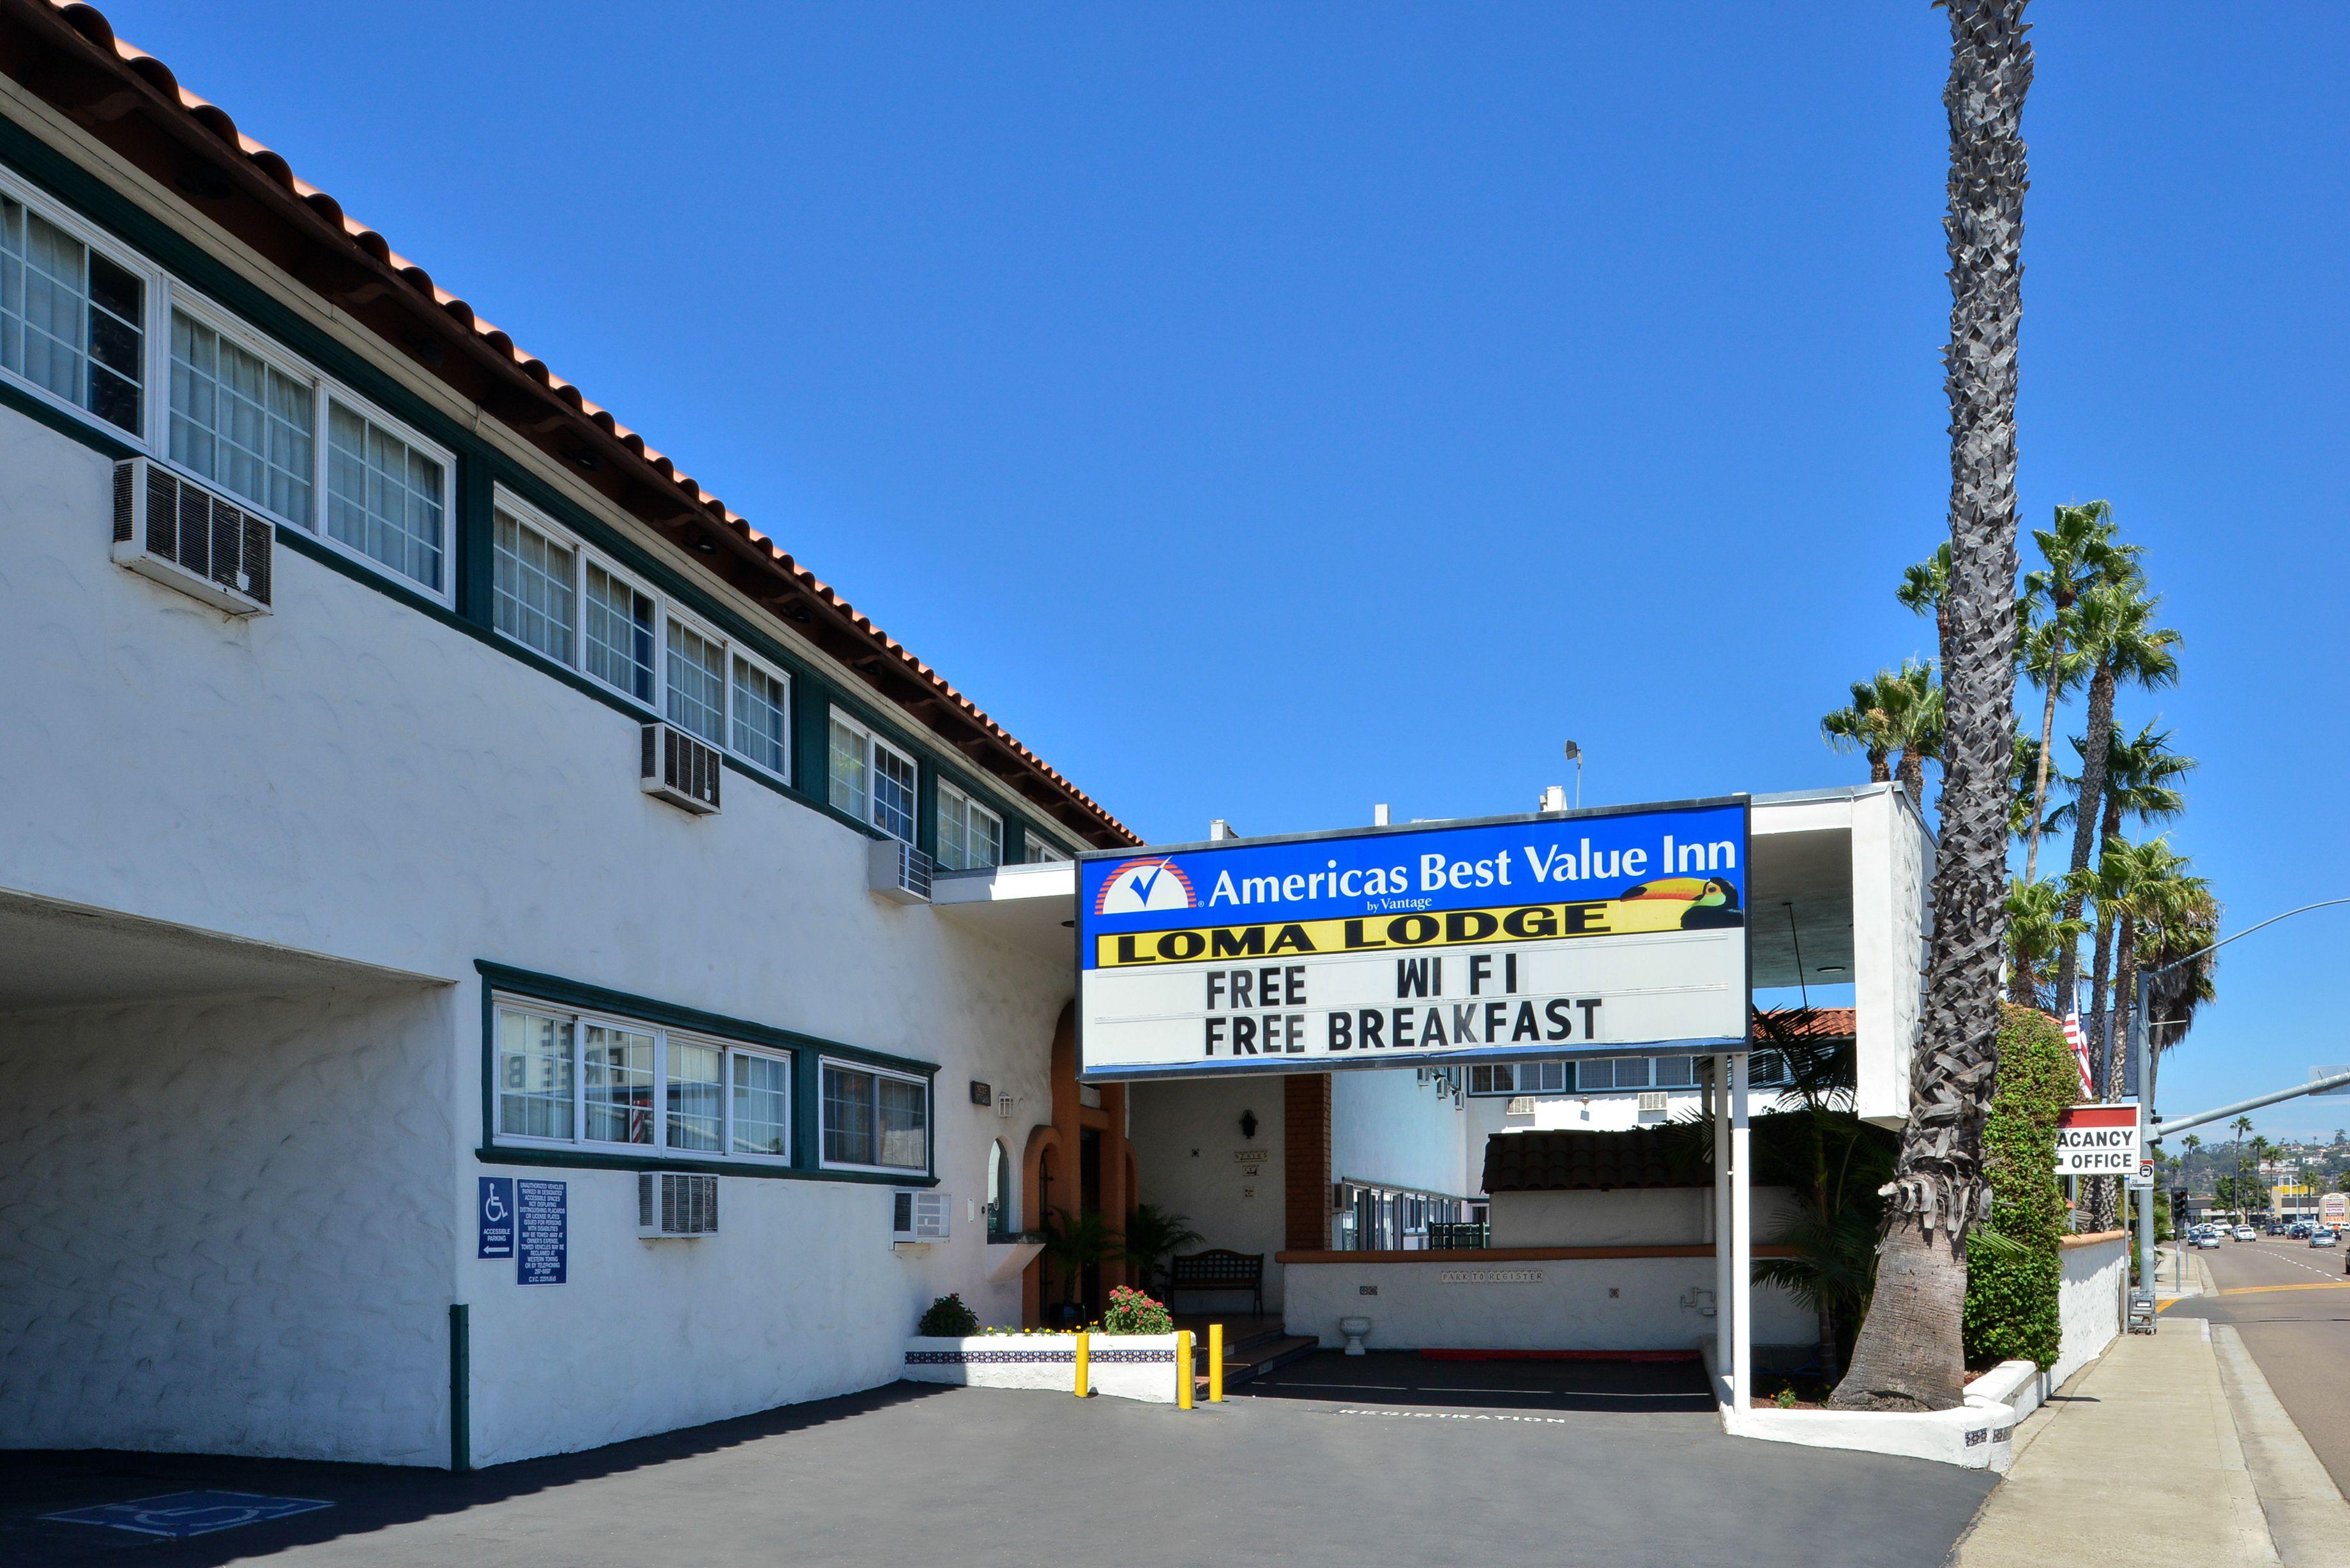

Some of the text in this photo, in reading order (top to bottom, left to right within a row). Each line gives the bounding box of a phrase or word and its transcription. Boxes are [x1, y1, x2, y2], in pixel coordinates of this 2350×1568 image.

[1208, 835, 1736, 907] Americas Best Value Inn
[1367, 898, 1432, 913] by Vantage
[1118, 903, 1612, 963] LOMA LODGE
[1207, 965, 1307, 1010] FREE
[1205, 998, 1602, 1056] FREE BREAKFAST
[2057, 1131, 2134, 1147] ACANCY
[2071, 1153, 2132, 1168] OFFICE
[1443, 1272, 1468, 1281] PARK
[1489, 1272, 1542, 1280] REGISTER
